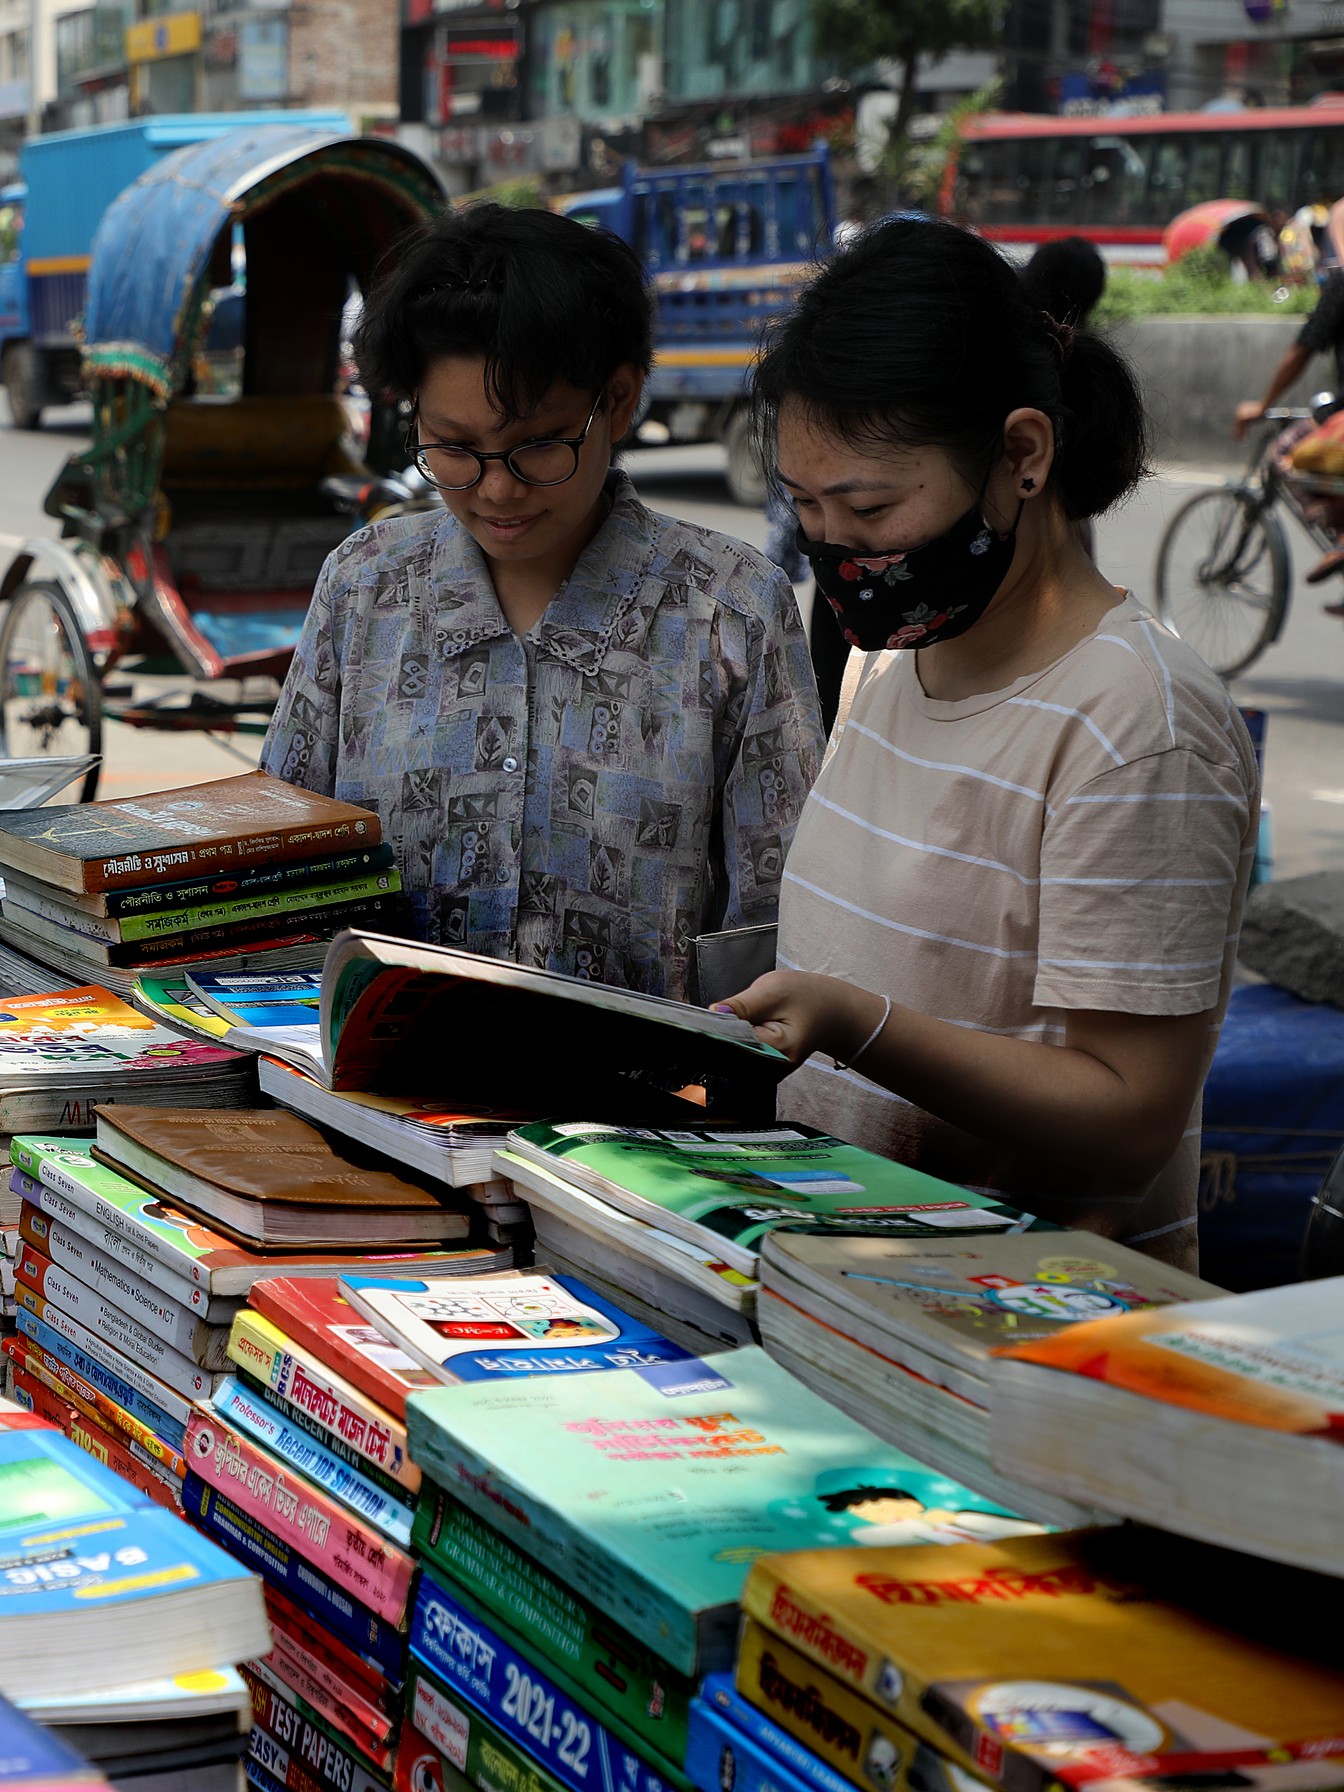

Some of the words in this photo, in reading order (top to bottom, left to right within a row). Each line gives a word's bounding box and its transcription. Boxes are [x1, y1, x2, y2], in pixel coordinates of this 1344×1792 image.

[103, 854, 142, 878] পৌরনীতি
[145, 858, 152, 869] ও
[152, 851, 189, 874] সুশাসন
[199, 846, 217, 859] প্রথম
[219, 844, 233, 857] পত্র
[121, 891, 162, 909] পৌরনীতি
[166, 891, 173, 900] ও
[176, 886, 208, 901] সুশাসন
[145, 909, 189, 931] সমাজকর্ম
[141, 936, 184, 954] সমাজকর্ম
[41, 1165, 56, 1182] Class
[57, 1175, 74, 1194] Seven
[43, 1192, 58, 1208] Class
[58, 1201, 76, 1220] Seven
[96, 1202, 125, 1230] ENGLISH
[136, 1229, 144, 1242] 2nd
[144, 1236, 159, 1252] Papers
[52, 1231, 66, 1247] Class
[66, 1240, 83, 1259] Seven
[104, 1230, 121, 1252] বাংলা
[47, 1276, 62, 1294] Class
[62, 1286, 79, 1304] Seven
[94, 1260, 131, 1295] Mathematics
[134, 1288, 159, 1315] Science
[162, 1308, 175, 1326] ICT
[46, 1309, 59, 1326] Class
[60, 1319, 77, 1338] Seven
[101, 1319, 118, 1338] Religion
[123, 1336, 136, 1351] Moral
[136, 1343, 157, 1365] Education
[103, 1307, 129, 1332] Bangladesh
[133, 1329, 148, 1346] Global
[147, 1339, 165, 1356] Studies
[238, 1336, 272, 1371] প্রফেসর'স
[277, 1353, 292, 1396] BCS
[474, 1353, 605, 1373] সমাহার
[264, 1386, 290, 1419] BANK
[291, 1402, 329, 1445] RECENT
[331, 1435, 360, 1469] MATH
[231, 1395, 276, 1436] Professor's
[274, 1428, 314, 1464] Recent
[311, 1454, 335, 1482] JOB
[330, 1469, 387, 1520] SOLUTION
[214, 1436, 249, 1486] জুপিটার
[248, 1466, 275, 1506] একের
[273, 1474, 300, 1525] ভিতর
[298, 1502, 331, 1549] এগারো
[213, 1512, 243, 1543] GRAMMAR
[242, 1536, 248, 1546] &
[247, 1539, 288, 1578] COMPOSITION
[214, 1501, 264, 1546] COMMUNICATIVE
[263, 1534, 289, 1565] ENGLISH
[346, 1530, 367, 1558] তৃতীয়
[5, 1546, 149, 1586] BASIC
[450, 1524, 538, 1604] COMMUNICATIVE
[537, 1592, 585, 1643] ENGLISH
[455, 1511, 516, 1566] ADVANCED
[515, 1557, 587, 1625] LEARNER'S
[297, 1564, 329, 1599] CHOWDHURY
[327, 1590, 333, 1602] &
[332, 1591, 354, 1619] HOSSAIN
[445, 1540, 497, 1591] GRAMMAR
[497, 1585, 506, 1598] &
[508, 1592, 582, 1662] COMPOSITION
[424, 1600, 497, 1684] ফোকাস
[269, 1693, 302, 1747] TEST
[300, 1722, 352, 1791] PAPERS
[501, 1662, 592, 1779] 2021-22
[278, 1758, 287, 1773] to
[759, 1726, 812, 1771] ADVANCED
